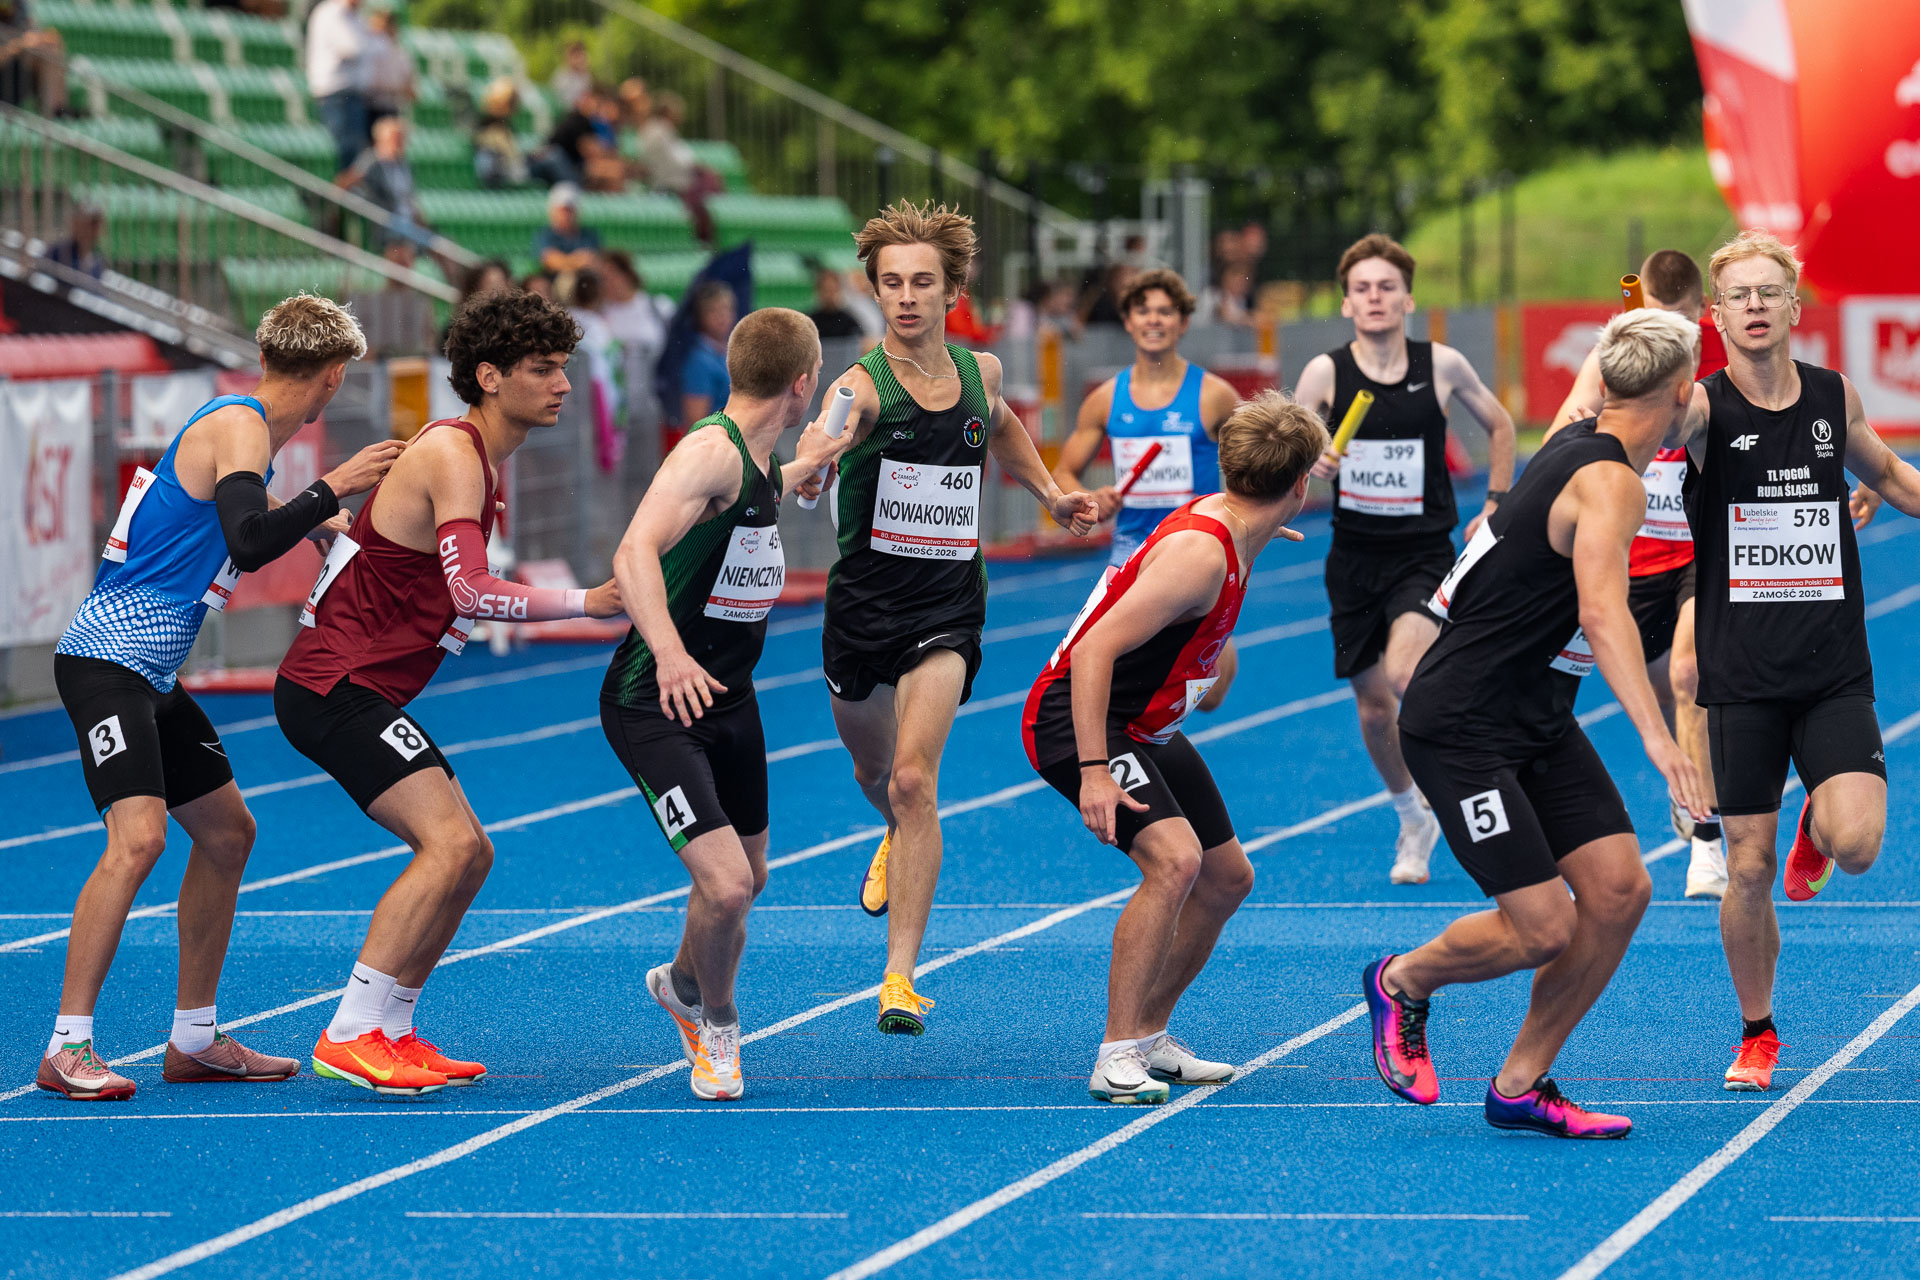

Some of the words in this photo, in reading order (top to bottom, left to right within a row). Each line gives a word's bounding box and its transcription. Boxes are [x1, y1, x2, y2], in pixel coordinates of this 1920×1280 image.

[1729, 434, 1760, 450] 4F
[1814, 443, 1834, 451] RUDA
[1383, 445, 1415, 460] 399
[940, 472, 973, 490] 460
[1351, 470, 1407, 488] MICAŁ
[1779, 465, 1810, 481] POGOŃ
[1757, 485, 1783, 497] RUDA
[1784, 483, 1819, 498] ŚLĄSKA
[879, 498, 974, 526] NOWAKOWSKI
[1793, 508, 1830, 527] 578
[906, 537, 941, 545] Mistrzostwa
[891, 544, 934, 556] ZAMOŚĆ
[934, 548, 957, 557] 2026
[1734, 543, 1836, 566] FEDKOW
[720, 565, 783, 588] NIEMCZYK
[1752, 589, 1797, 599] ZAMOŚĆ
[1798, 590, 1822, 598] 2026
[723, 609, 754, 619] ZAMOŚĆ
[95, 724, 116, 756] 3
[392, 722, 422, 751] 8
[1110, 759, 1141, 790] 2
[666, 794, 686, 828] 4
[1472, 796, 1497, 835] 5
